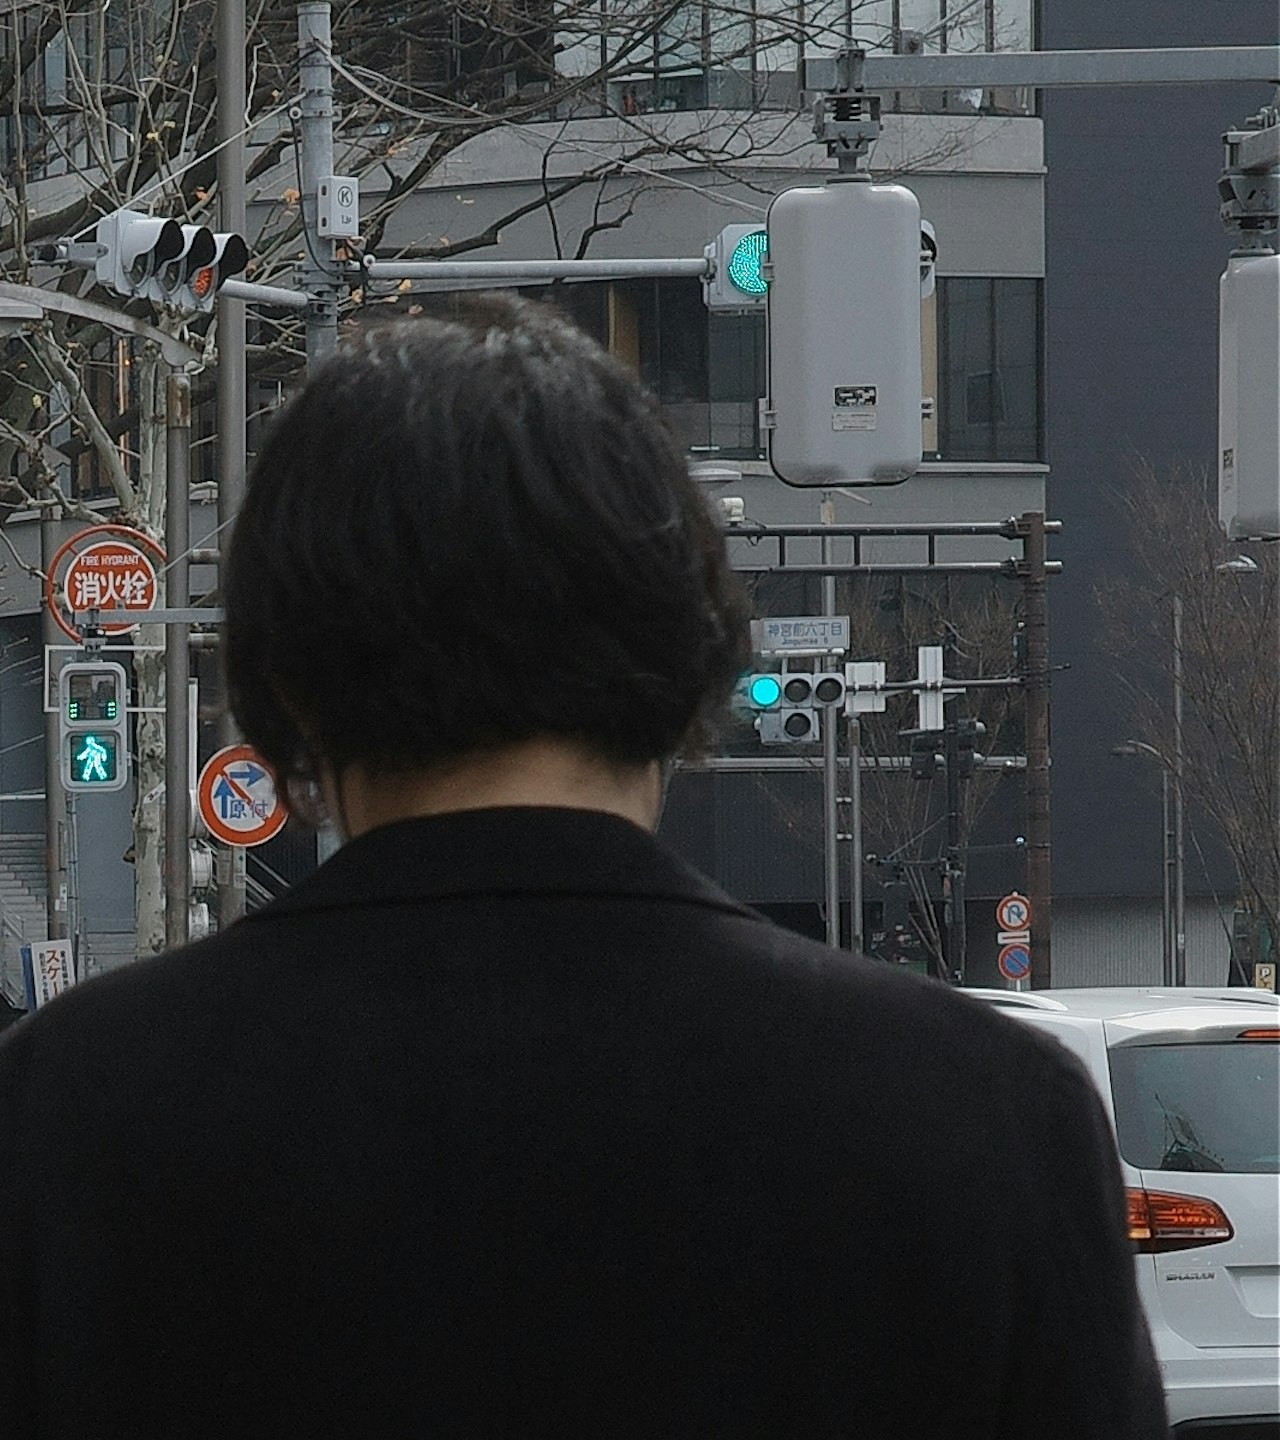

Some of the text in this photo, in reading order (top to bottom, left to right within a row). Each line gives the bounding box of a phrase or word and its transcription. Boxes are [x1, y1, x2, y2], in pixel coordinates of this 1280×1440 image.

[80, 553, 140, 566] FIRE HYDRANT
[74, 569, 148, 606] 消火栓
[767, 621, 843, 637] 神宮前六丁目
[229, 799, 269, 820] 原付
